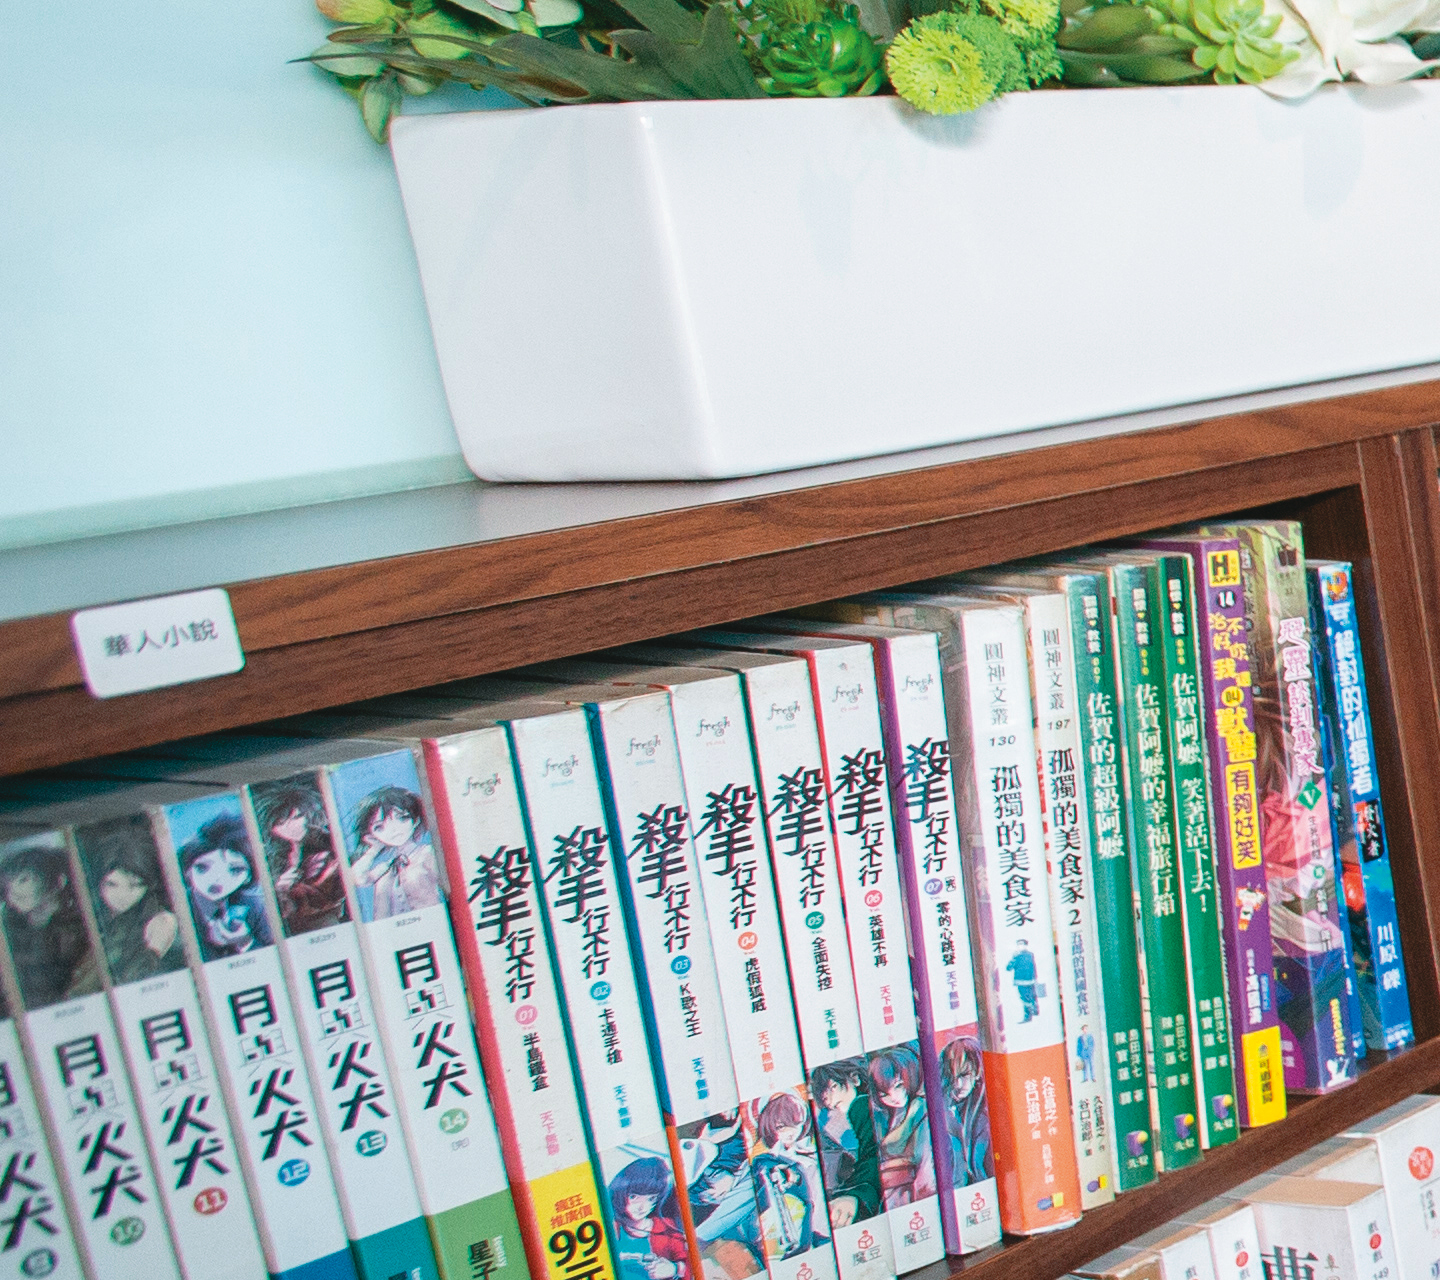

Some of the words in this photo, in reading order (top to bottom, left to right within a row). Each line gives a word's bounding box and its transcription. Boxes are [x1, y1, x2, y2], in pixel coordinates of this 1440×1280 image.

[102, 619, 219, 659] 華人小說
[989, 734, 1016, 747] 130
[1047, 718, 1071, 731] 197
[1172, 672, 1201, 766] 佐賀阿嬤
[1086, 692, 1125, 860] 佐賀的超級阿嬤
[1135, 683, 1176, 917] 佐賀阿嬤的幸福旅行箱
[1230, 768, 1258, 863] 有夠好笑
[990, 763, 1036, 928] 孤獨的美食家
[1047, 747, 1085, 904] 孤獨的美食家
[1068, 908, 1083, 927] 2
[549, 1219, 603, 1266] 99
